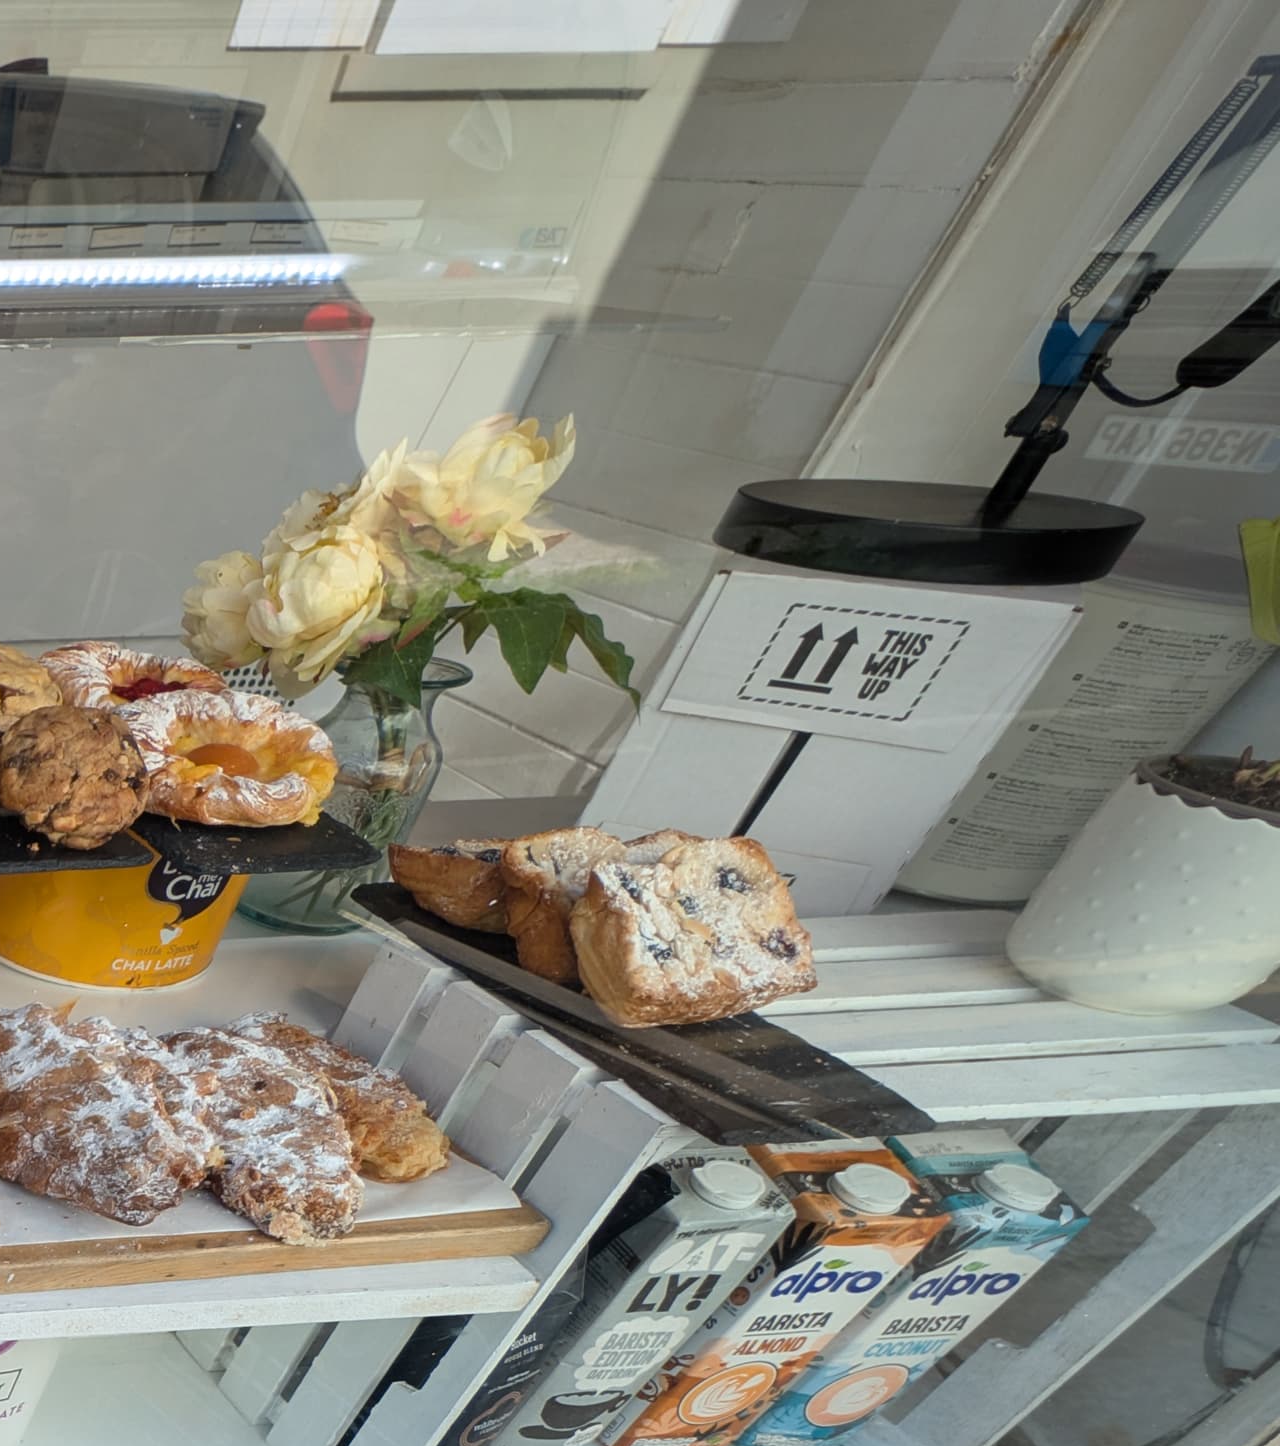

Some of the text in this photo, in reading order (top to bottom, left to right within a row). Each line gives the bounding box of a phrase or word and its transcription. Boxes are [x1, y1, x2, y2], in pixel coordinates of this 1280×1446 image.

[878, 629, 934, 656] THIS
[861, 653, 920, 680] WAY
[857, 678, 890, 701] UP
[165, 875, 223, 900] Chai
[198, 874, 218, 884] me
[111, 954, 194, 971] CHAI LATTE
[770, 1261, 884, 1303] alpro
[907, 1264, 1022, 1306] alpro
[625, 1273, 723, 1314] LY!
[747, 1312, 833, 1333] BARISTA
[881, 1314, 971, 1336] BARISTA
[602, 1331, 675, 1350] BARISTA
[733, 1336, 808, 1356] ALMOND
[863, 1338, 951, 1358] COCONUT
[592, 1349, 661, 1368] EDITION
